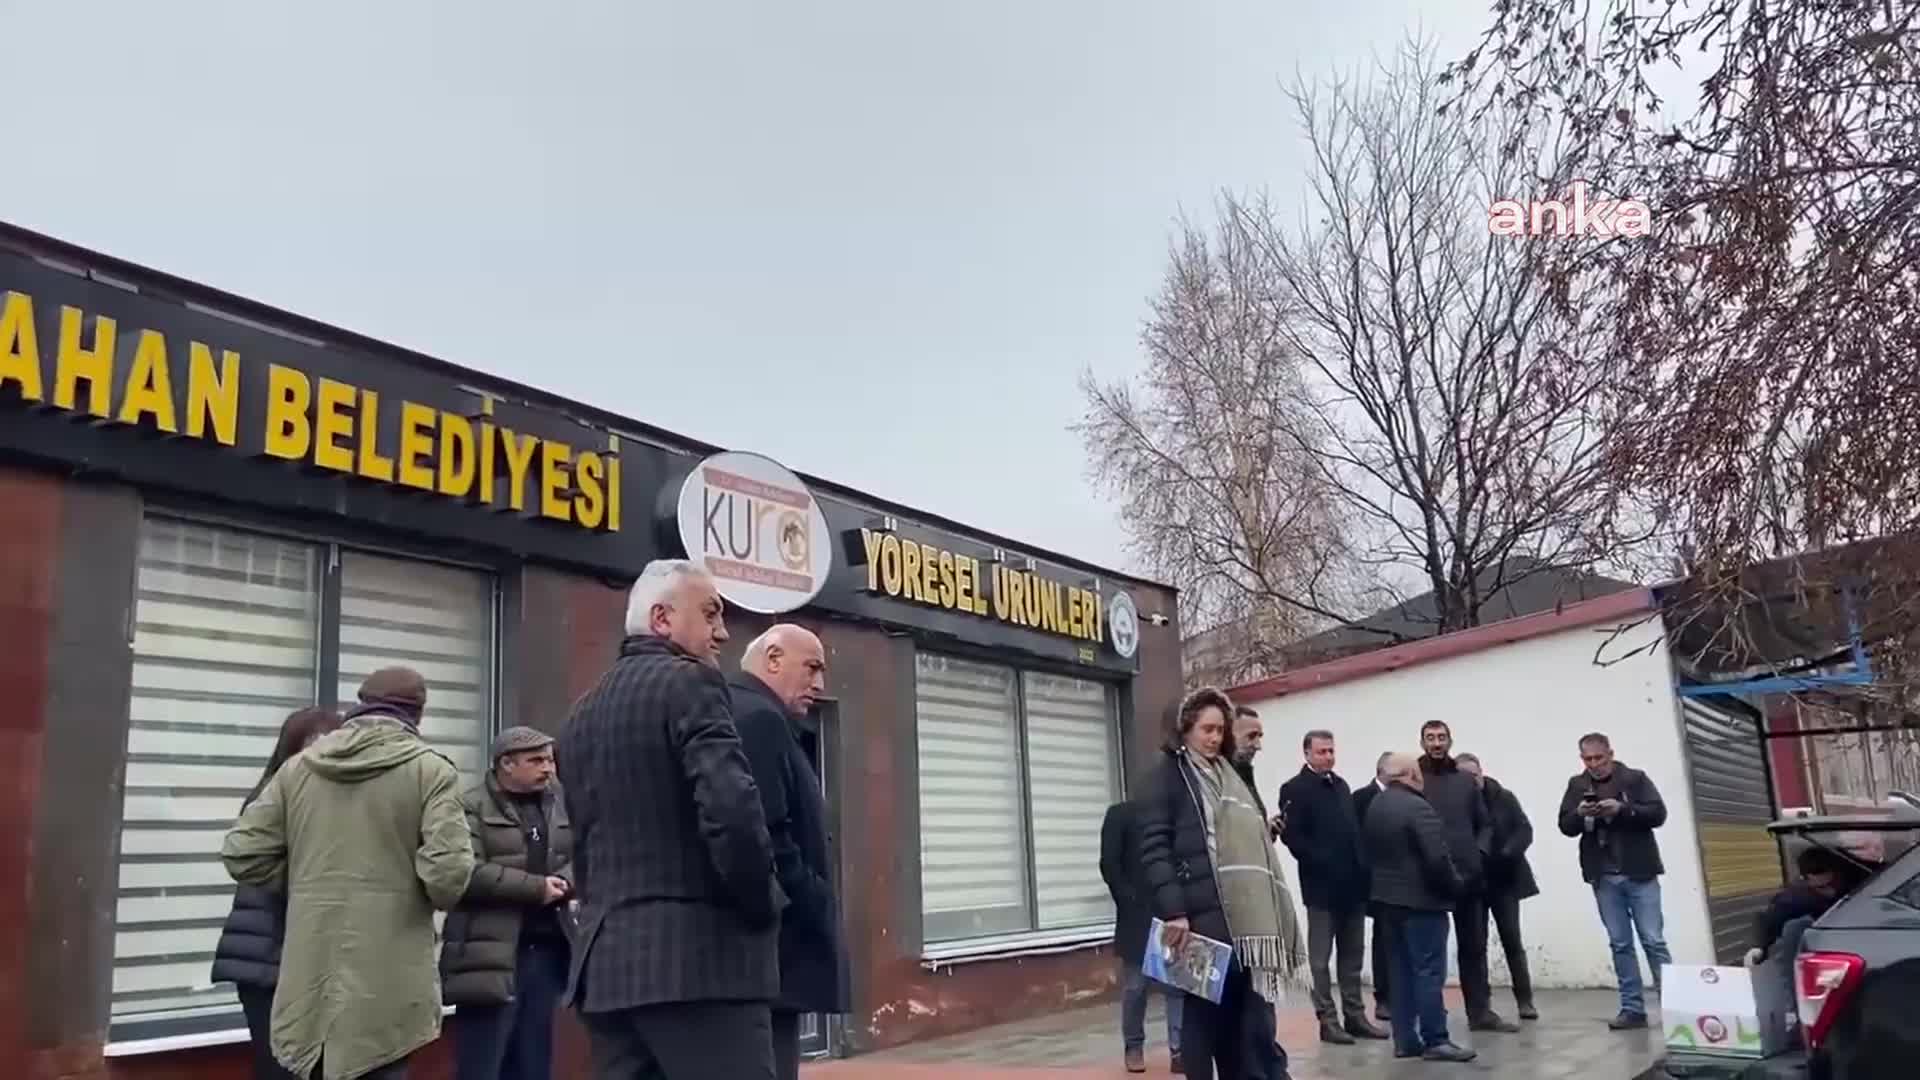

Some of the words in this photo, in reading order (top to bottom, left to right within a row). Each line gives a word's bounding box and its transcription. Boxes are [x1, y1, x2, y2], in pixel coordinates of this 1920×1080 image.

[0, 290, 240, 446] AHAN
[264, 362, 622, 532] BELEDİYESİ
[860, 516, 988, 616] YÖRESEL
[991, 548, 1103, 642] ÜRÜNLERİ
